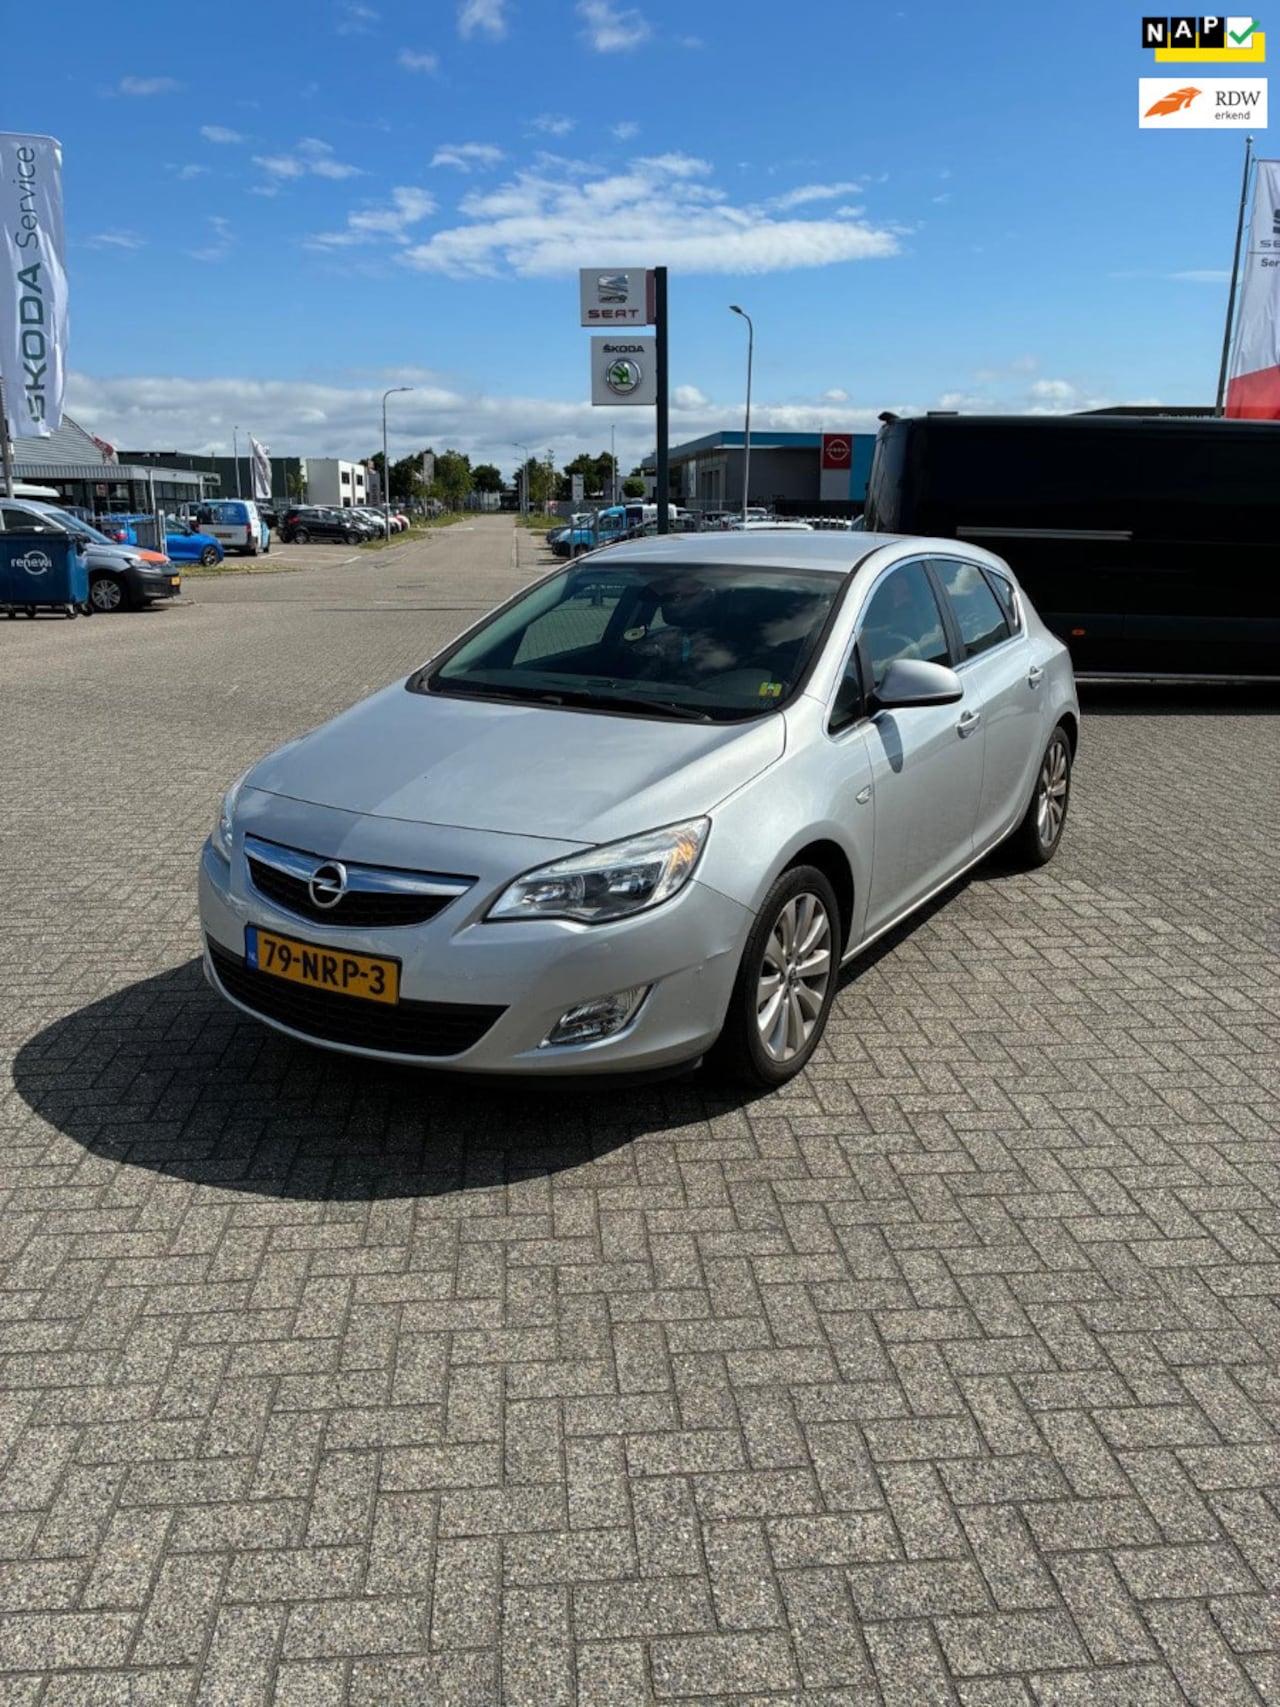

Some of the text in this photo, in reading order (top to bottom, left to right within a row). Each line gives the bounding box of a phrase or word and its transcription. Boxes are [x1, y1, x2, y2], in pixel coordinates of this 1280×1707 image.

[12, 146, 39, 249] Service
[587, 309, 639, 319] SEAT
[10, 557, 52, 568] renewi
[264, 939, 385, 995] 79-NRP-3
